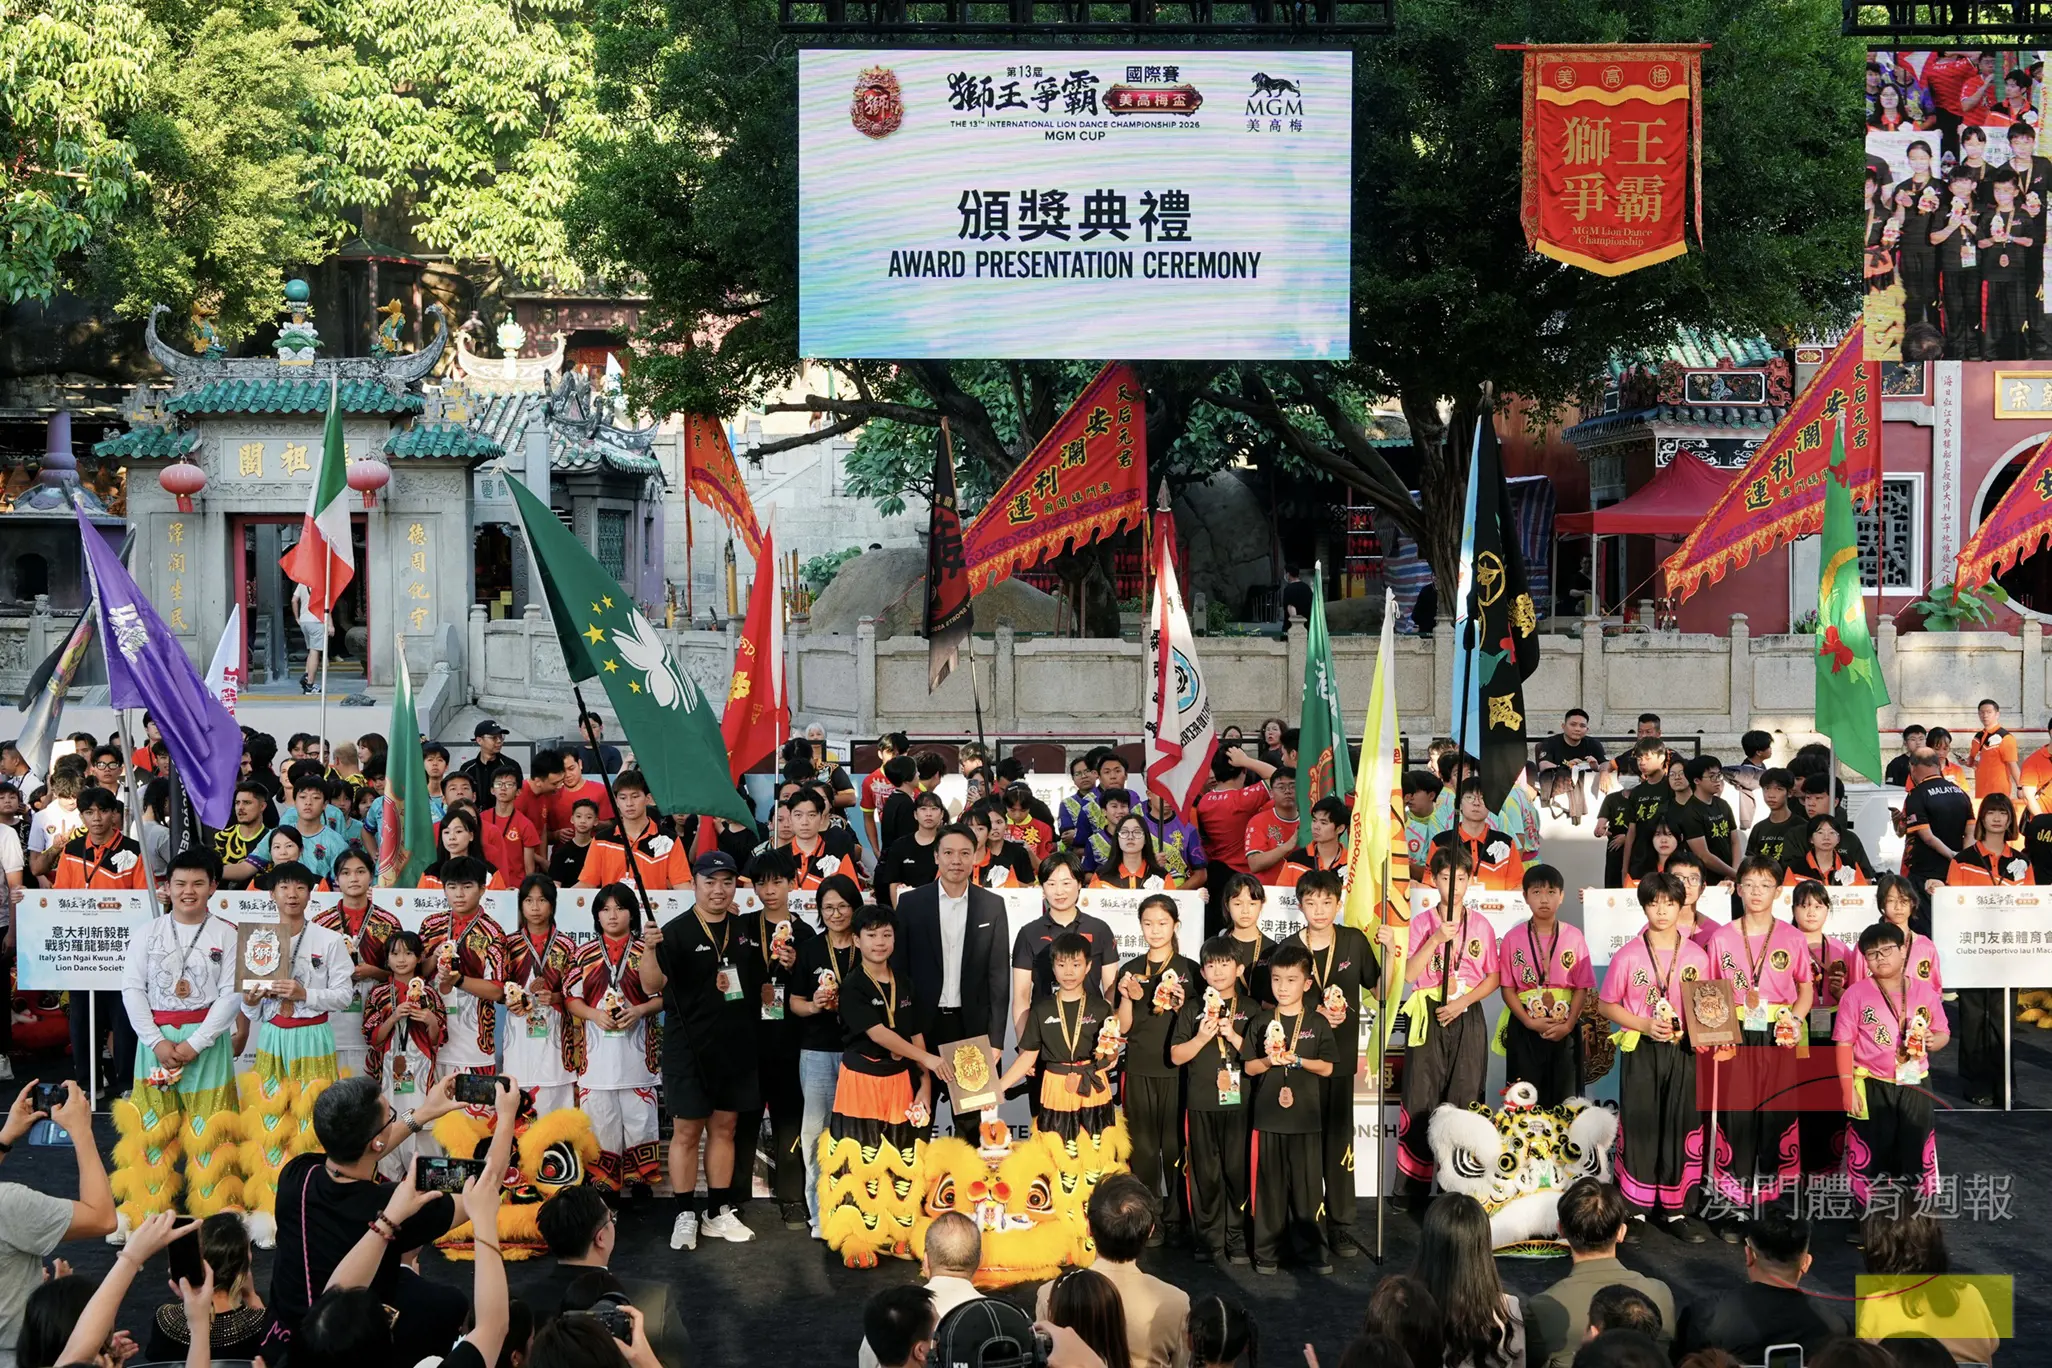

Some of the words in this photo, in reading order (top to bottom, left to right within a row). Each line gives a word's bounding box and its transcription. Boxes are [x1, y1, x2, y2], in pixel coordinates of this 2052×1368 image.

[1126, 66, 1179, 83] 國際賽
[1557, 68, 1669, 86] 美高梅
[947, 69, 1100, 117] 獅王爭霸
[1119, 93, 1187, 107] 美高梅盃
[1245, 99, 1304, 116] MGM
[1246, 118, 1303, 133] 美高梅
[1045, 131, 1075, 141] MGM
[1079, 131, 1106, 141] CUP
[1561, 116, 1667, 166] 獅王
[1560, 172, 1667, 223] 爭霸
[957, 189, 1193, 243] 頒獎典禮
[1572, 226, 1600, 236] MGM
[1601, 226, 1623, 236] Lion
[1623, 226, 1652, 237] Dance
[1578, 235, 1644, 247] Championship
[888, 251, 966, 279] AWARD
[975, 251, 1134, 279] PRESENTATION
[1143, 251, 1262, 279] CEREMONY
[1852, 363, 1871, 449] 天后元君
[1116, 383, 1135, 469] 天后元君
[168, 522, 188, 632] 澤潤生民
[38, 954, 56, 963] Italy
[73, 954, 91, 963] Ngai
